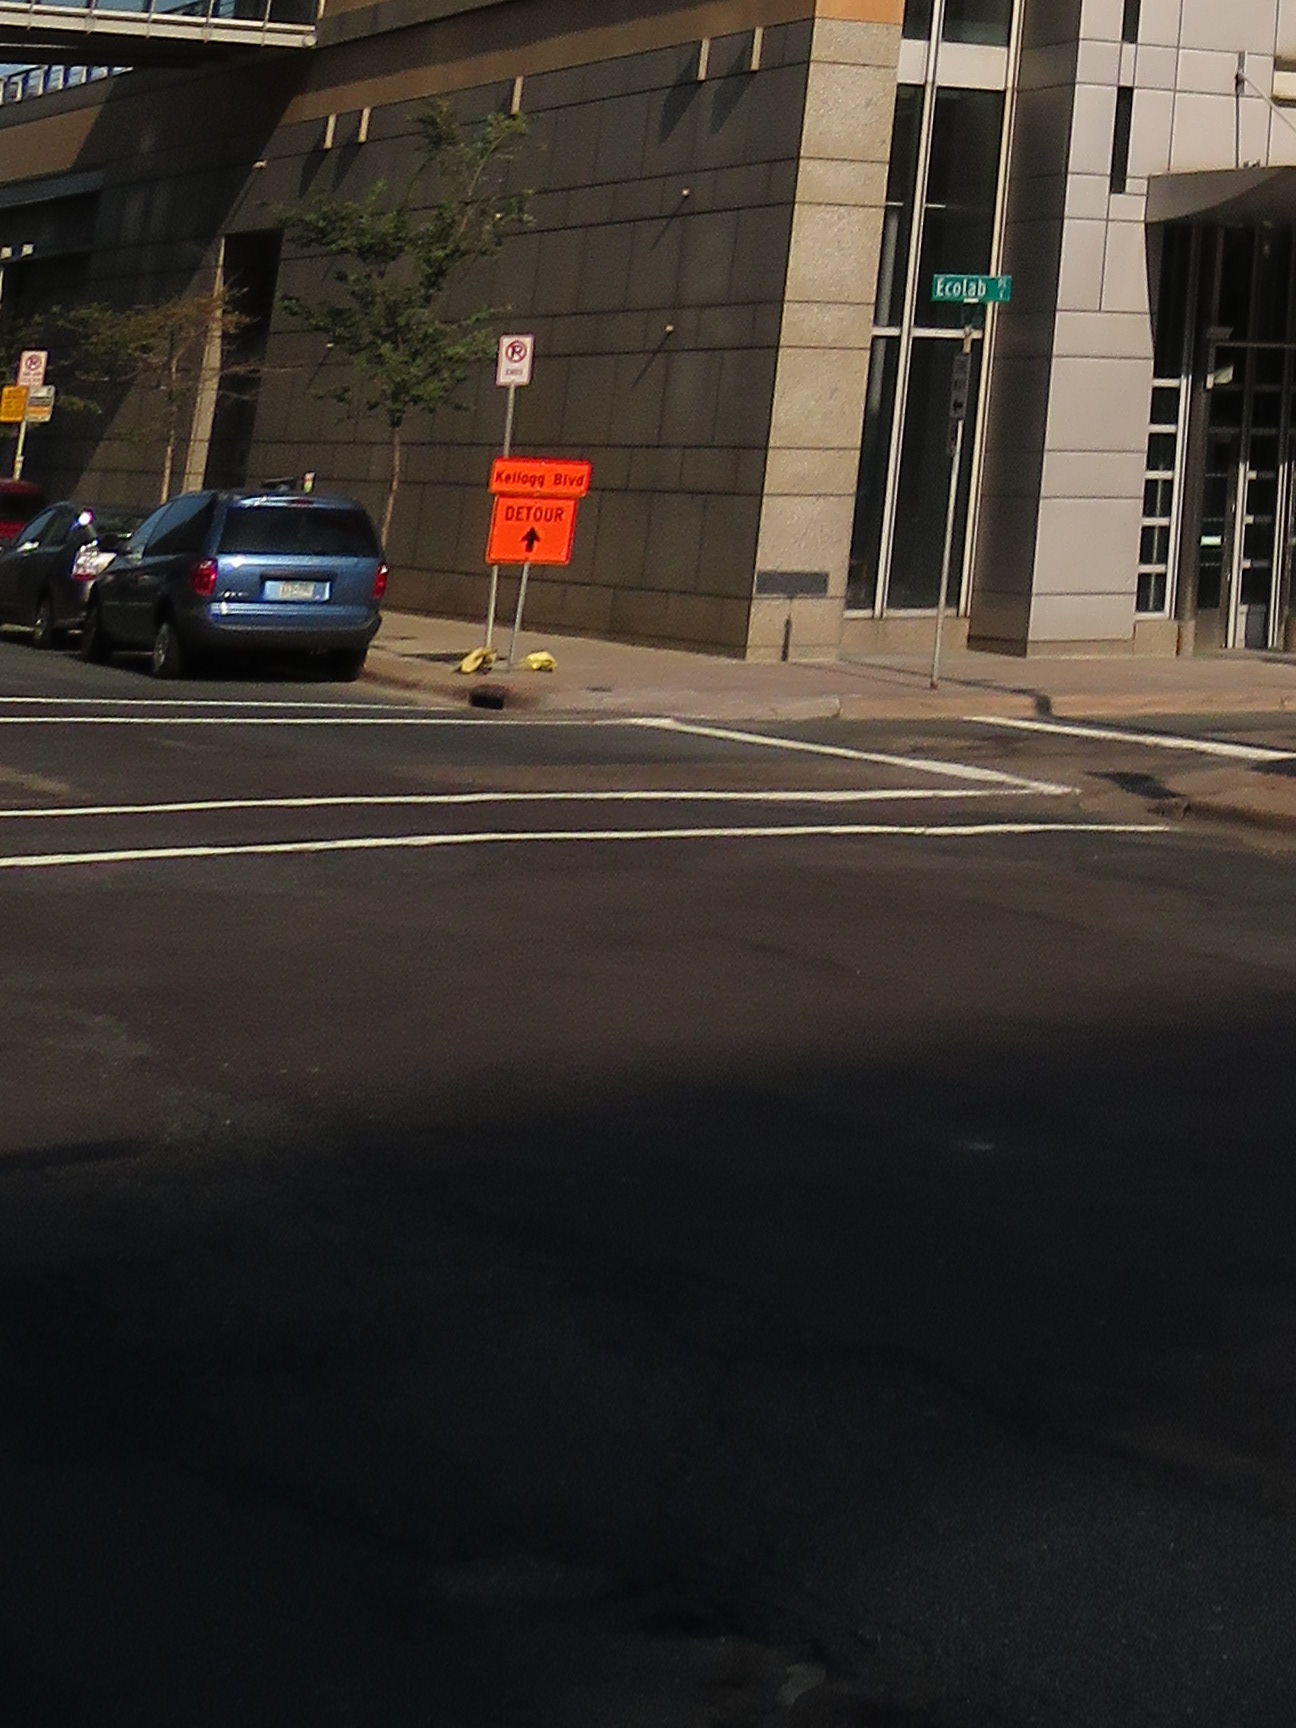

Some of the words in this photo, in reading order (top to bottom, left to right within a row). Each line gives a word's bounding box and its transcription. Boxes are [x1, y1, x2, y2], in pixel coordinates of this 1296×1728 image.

[936, 278, 986, 297] Ecolab
[495, 471, 546, 488] Kellogg
[553, 473, 585, 487] Blvd
[505, 506, 565, 522] DETOUR
